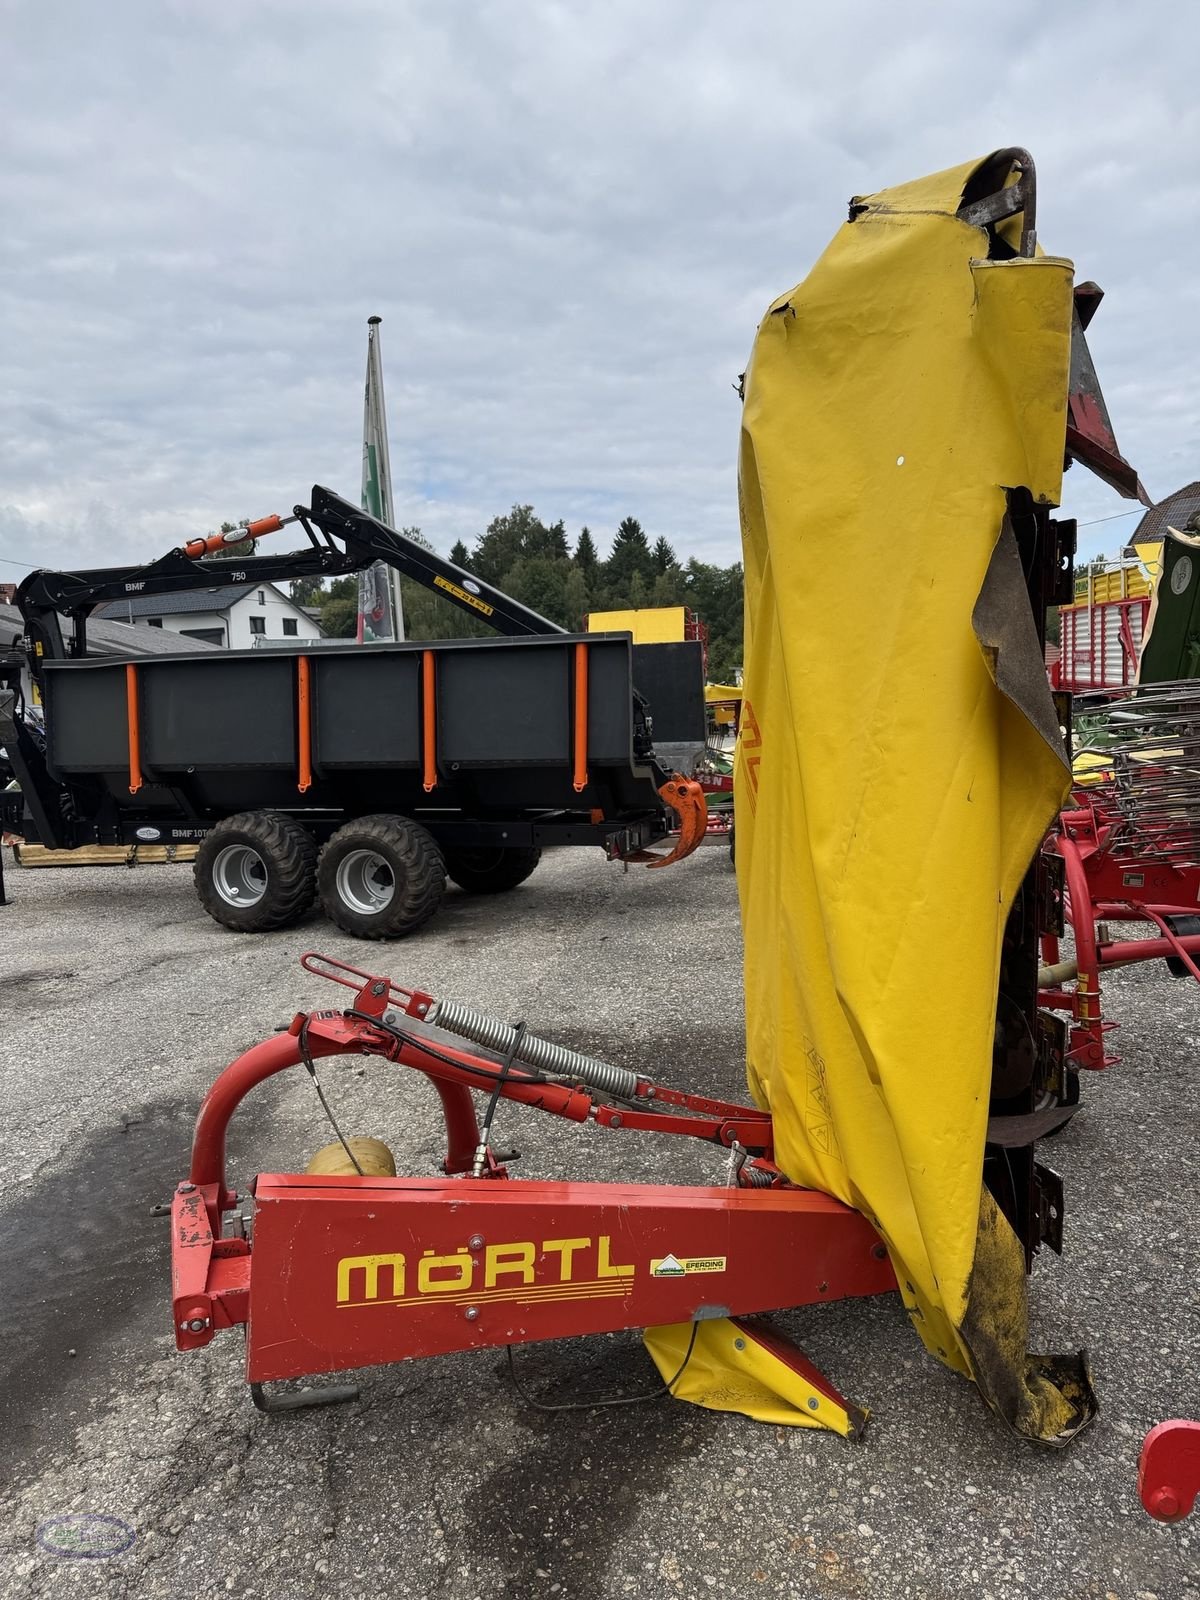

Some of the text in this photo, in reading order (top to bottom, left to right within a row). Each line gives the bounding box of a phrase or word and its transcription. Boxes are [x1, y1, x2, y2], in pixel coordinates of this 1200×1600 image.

[231, 572, 247, 582] 750
[125, 582, 146, 592] BMF
[712, 776, 723, 786] N
[172, 829, 193, 838] BMF
[337, 1235, 635, 1302] MÖRTL
[685, 1260, 724, 1269] EFERDING
